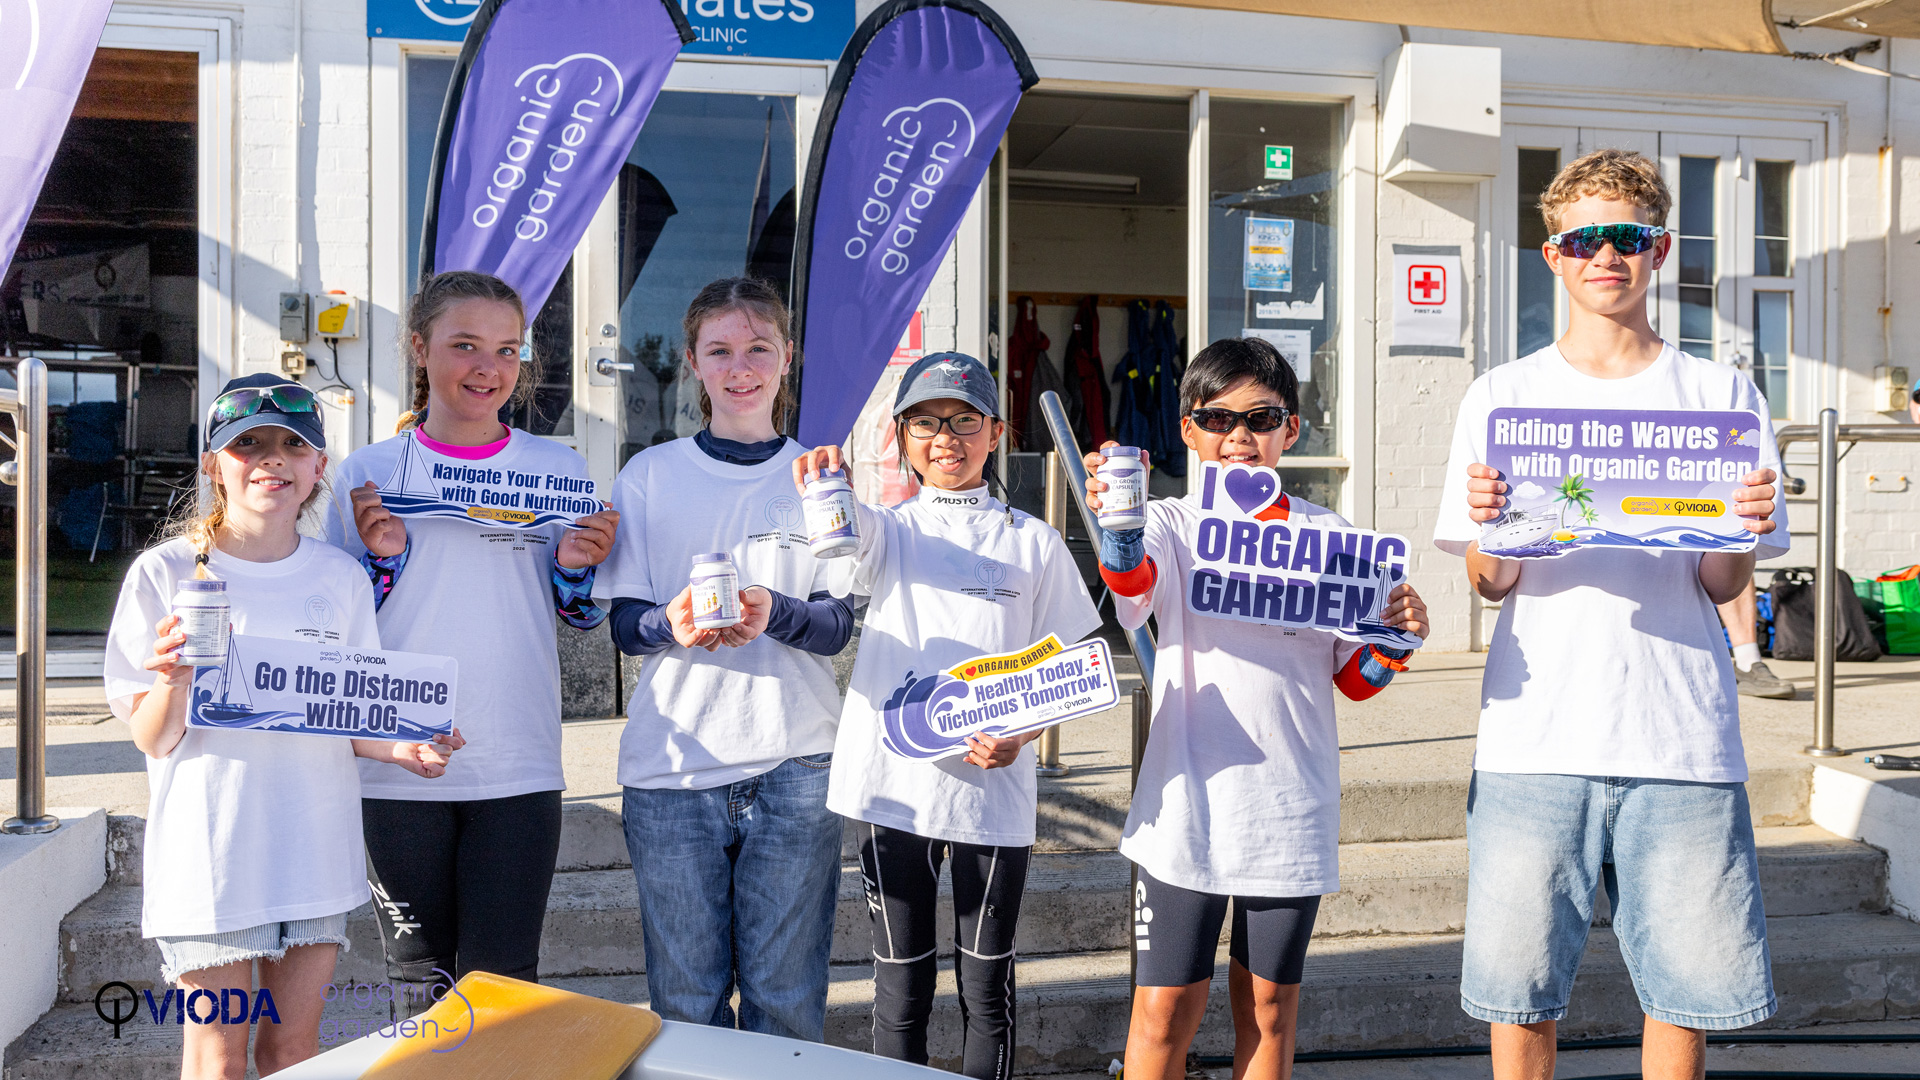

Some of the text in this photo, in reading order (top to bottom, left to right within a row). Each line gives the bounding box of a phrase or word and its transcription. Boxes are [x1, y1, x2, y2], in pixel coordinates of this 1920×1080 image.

[691, 26, 747, 44] CLINIC
[473, 74, 560, 228] organic
[515, 98, 601, 242] garden
[845, 117, 921, 259] organic
[881, 141, 955, 275] garden
[1494, 418, 1719, 450] Riding the Waves
[432, 463, 595, 494] Navigate Your Future
[1511, 452, 1752, 482] with Organic Garden
[442, 486, 593, 515] with Good Nutrition
[932, 497, 978, 505] MUSTO
[1201, 466, 1218, 510] I
[1686, 503, 1718, 512] VIODA
[1197, 517, 1405, 582] ORGANIC
[1191, 568, 1376, 629] GARDEN
[363, 655, 386, 665] VIODA
[977, 659, 1019, 674] ORGANIC
[1021, 641, 1055, 666] GARDEN
[255, 661, 448, 706] Go the Distance
[974, 658, 1090, 703] Healthy Today.
[306, 699, 398, 733] with OG
[937, 673, 1108, 733] Victorious Tomorrow.
[1071, 697, 1092, 707] VIODA
[995, 1044, 1004, 1080] HOBIC
